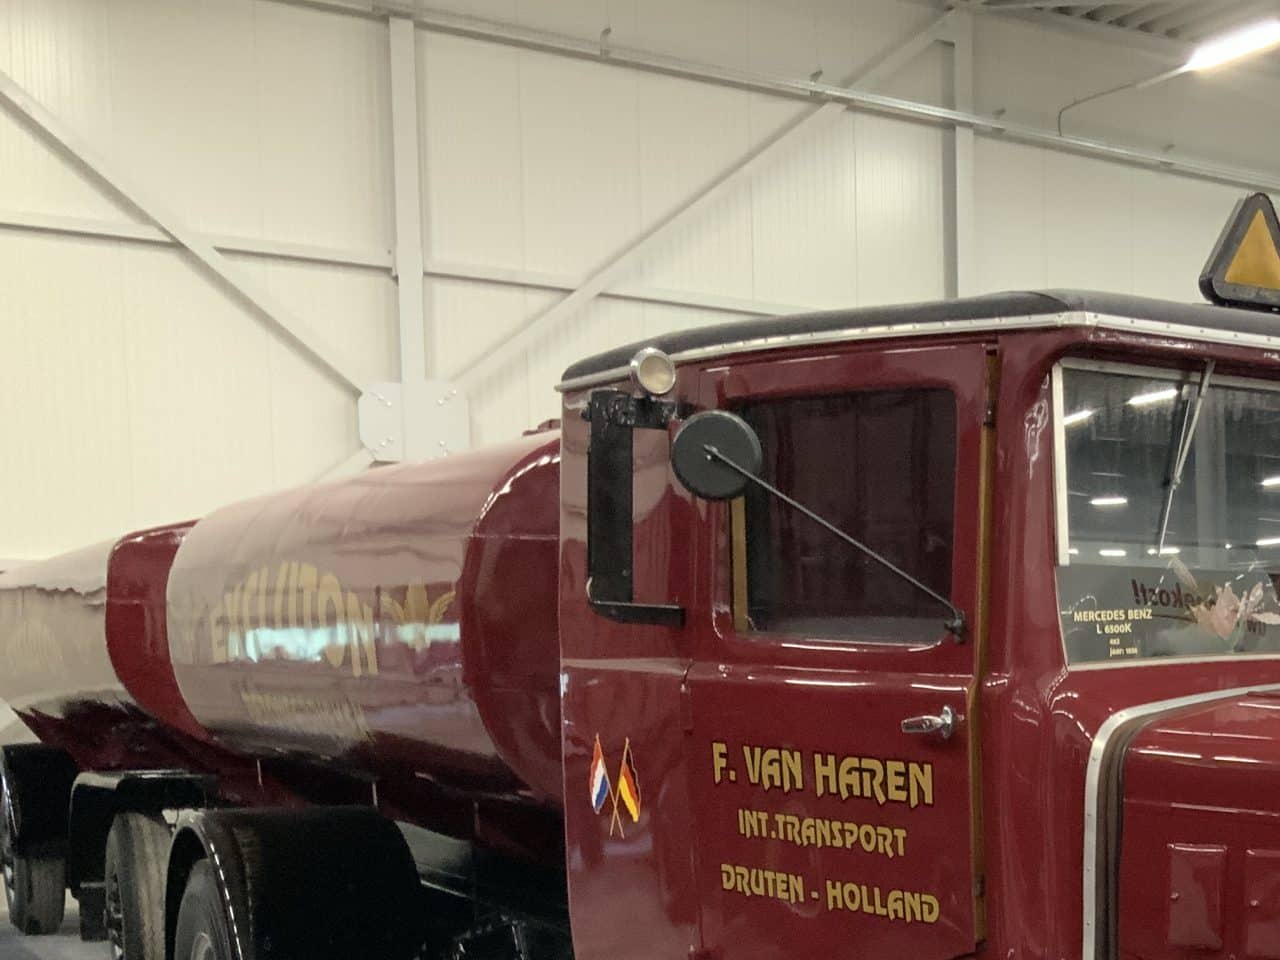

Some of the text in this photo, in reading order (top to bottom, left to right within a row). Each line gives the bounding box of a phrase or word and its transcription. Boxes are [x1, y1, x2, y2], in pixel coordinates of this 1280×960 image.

[1073, 608, 1153, 622] MERCEDES BENZ
[1096, 623, 1103, 634] L
[712, 742, 934, 809] F. VAN HAREN
[721, 863, 804, 905] DRUTEN
[826, 880, 940, 924] HOLLAND
